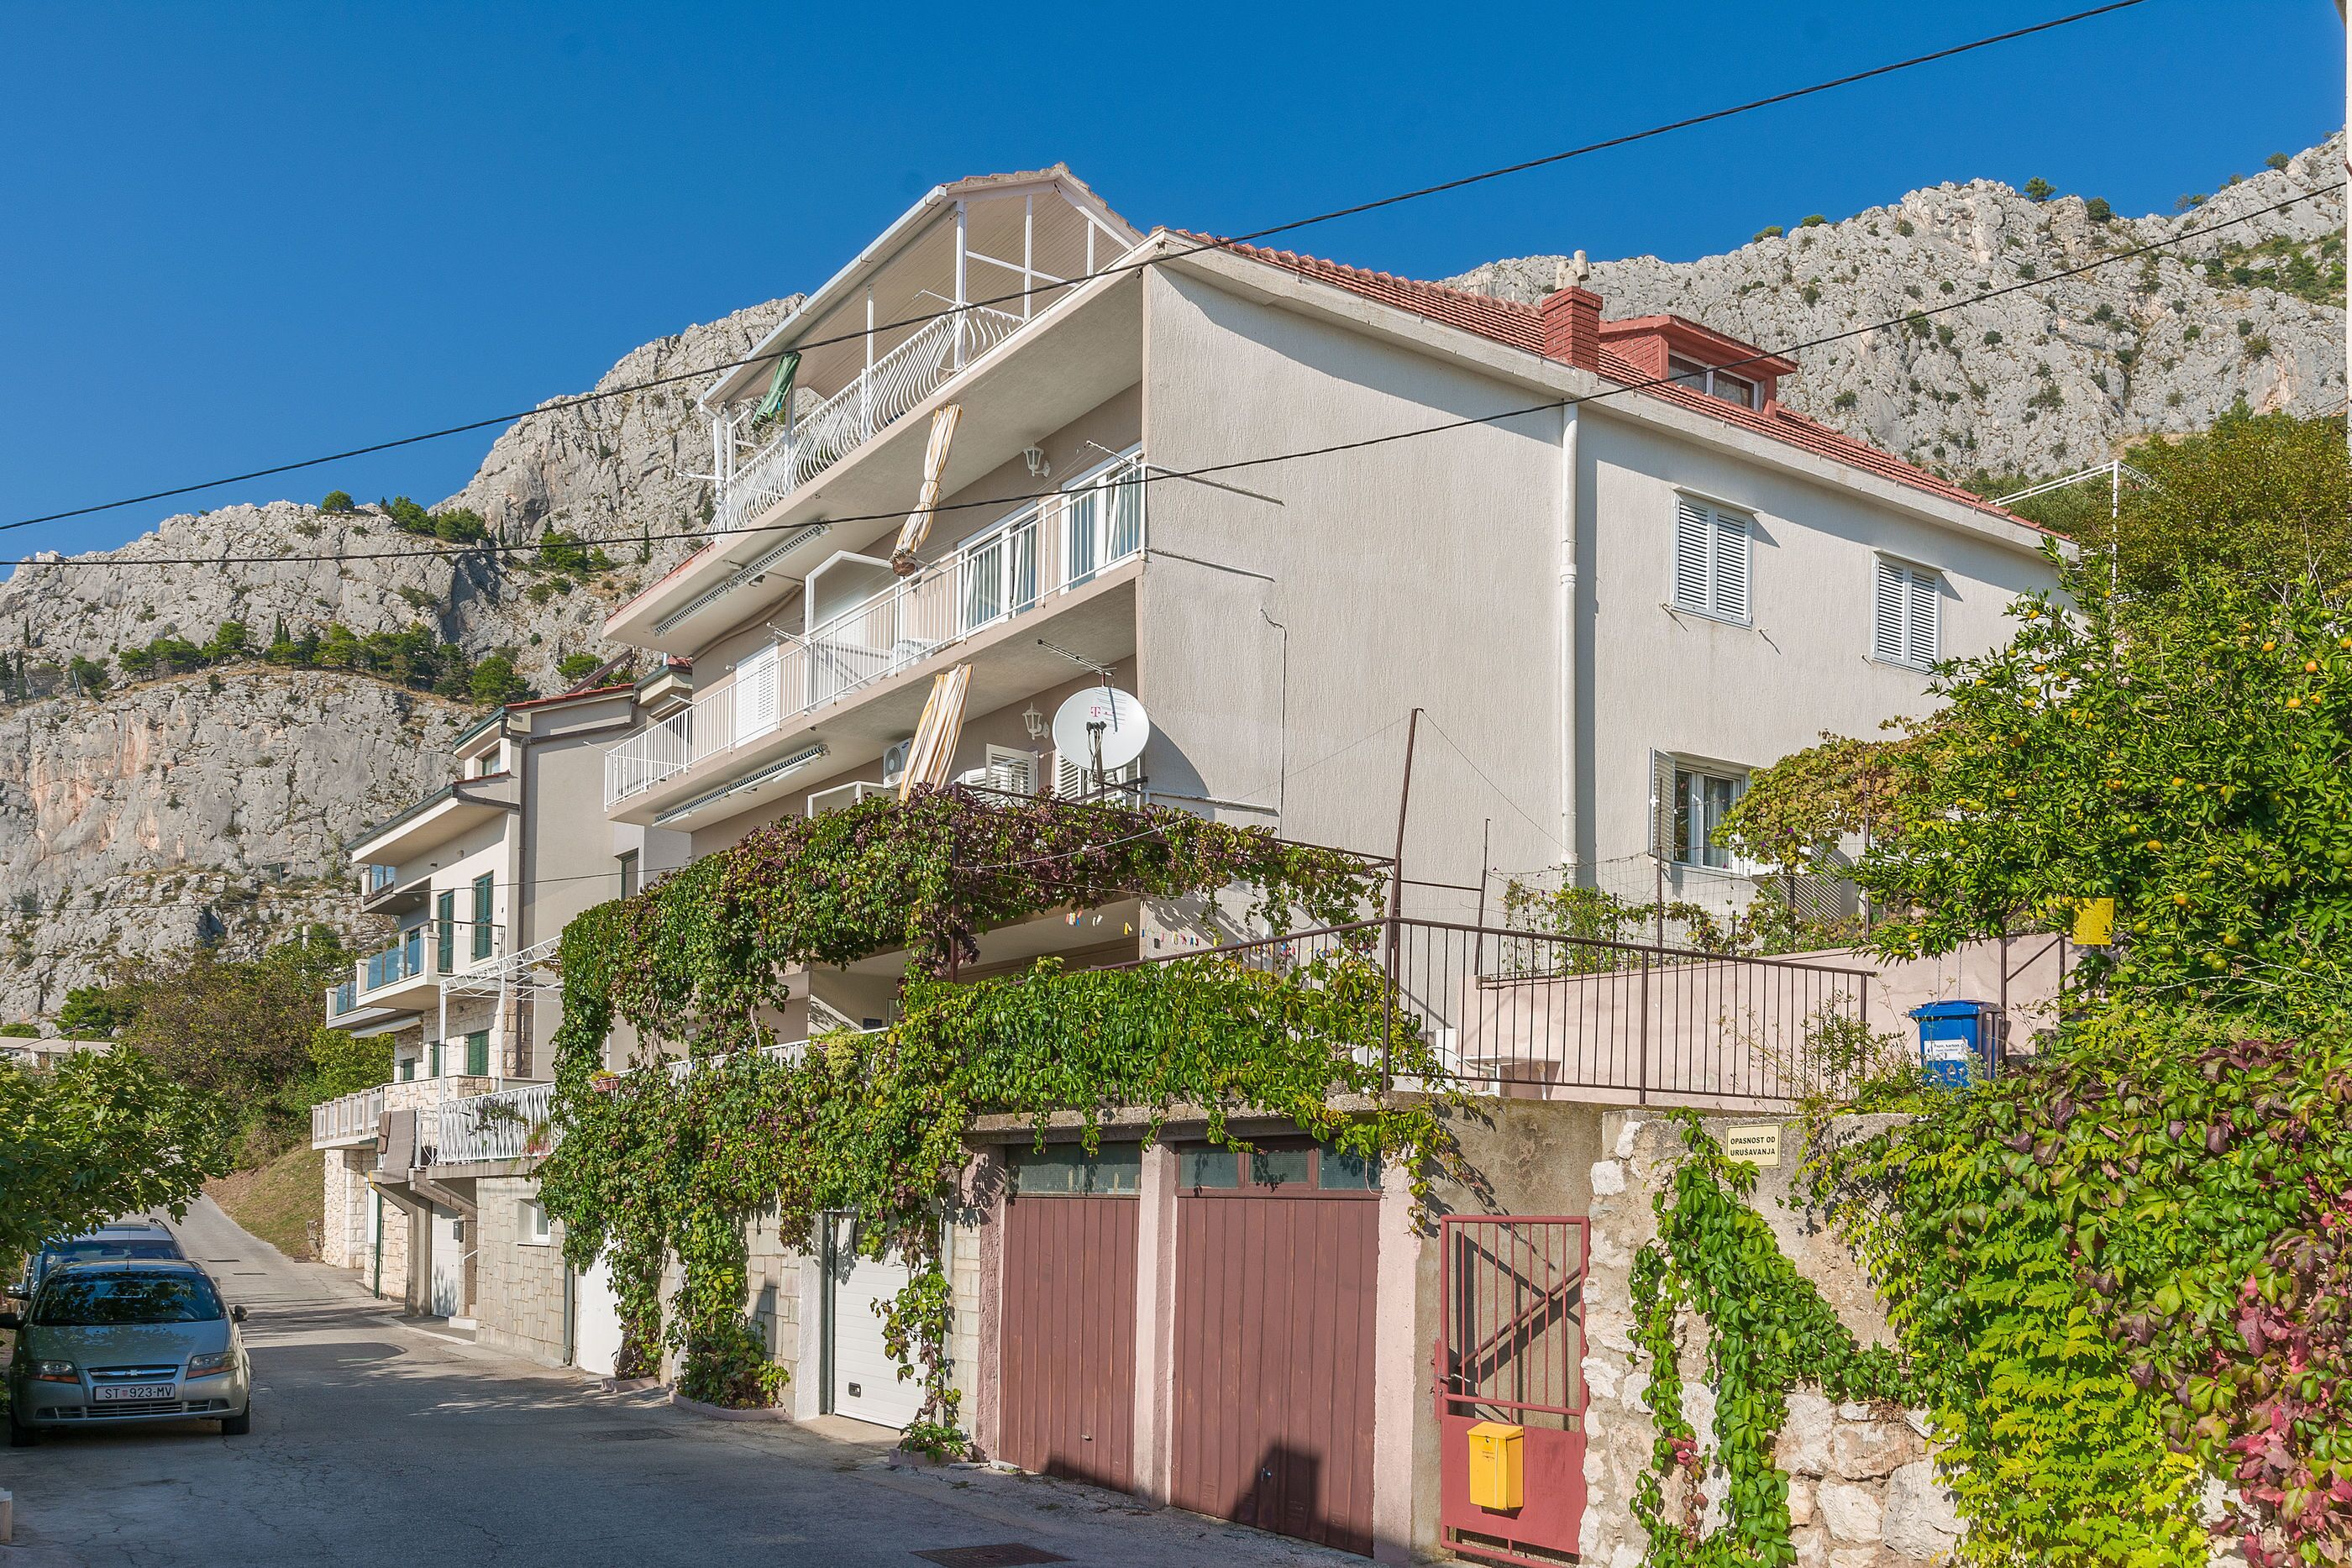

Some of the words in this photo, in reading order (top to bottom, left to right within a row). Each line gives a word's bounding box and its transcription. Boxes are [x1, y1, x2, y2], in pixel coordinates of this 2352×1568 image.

[1730, 1136, 1764, 1145] OPASNOST
[1730, 1148, 1775, 1156] URUŠAVANJA
[105, 1388, 120, 1398] ST
[129, 1387, 172, 1398] 923-MV
